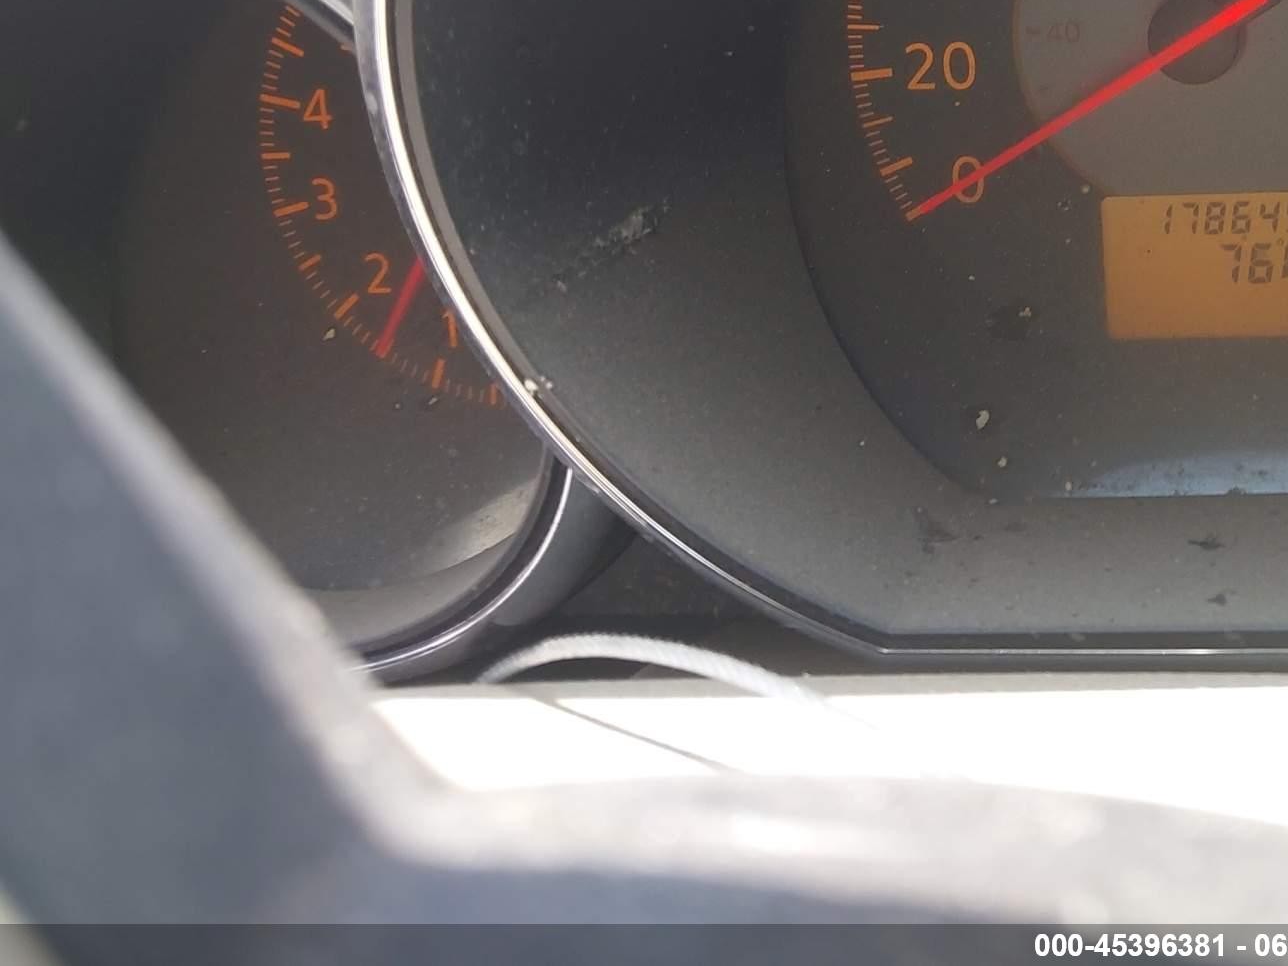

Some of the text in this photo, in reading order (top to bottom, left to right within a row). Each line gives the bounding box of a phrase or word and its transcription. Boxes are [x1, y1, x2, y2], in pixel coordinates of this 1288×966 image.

[905, 41, 977, 90] 20
[303, 88, 332, 129] 4
[311, 178, 338, 221] 3
[952, 156, 984, 203] 0
[365, 253, 391, 295] 2
